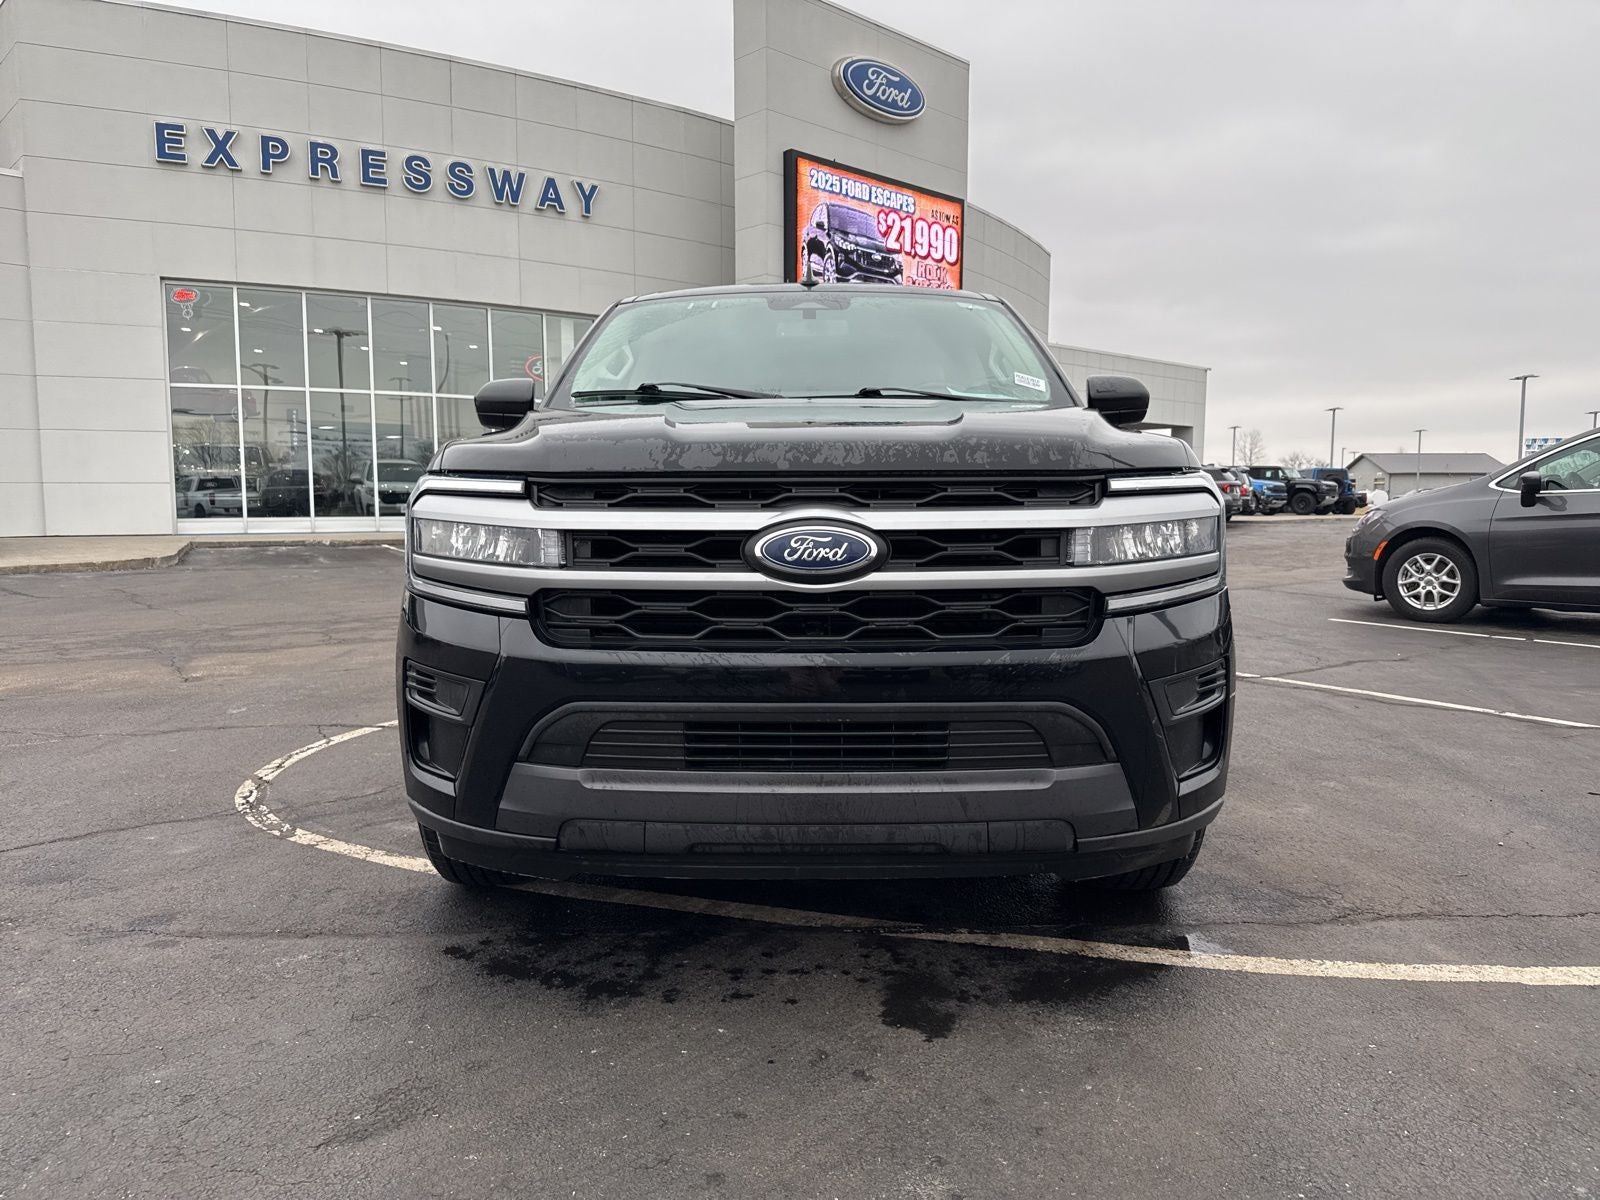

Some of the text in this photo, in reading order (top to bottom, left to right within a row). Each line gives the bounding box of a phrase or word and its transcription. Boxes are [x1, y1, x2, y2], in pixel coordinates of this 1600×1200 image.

[863, 67, 912, 108] Ford
[153, 120, 599, 217] EXPRESSWAY
[810, 168, 916, 214] 2025 FORD ESCAPES
[877, 209, 959, 267] $21,990
[784, 535, 848, 562] Ford
